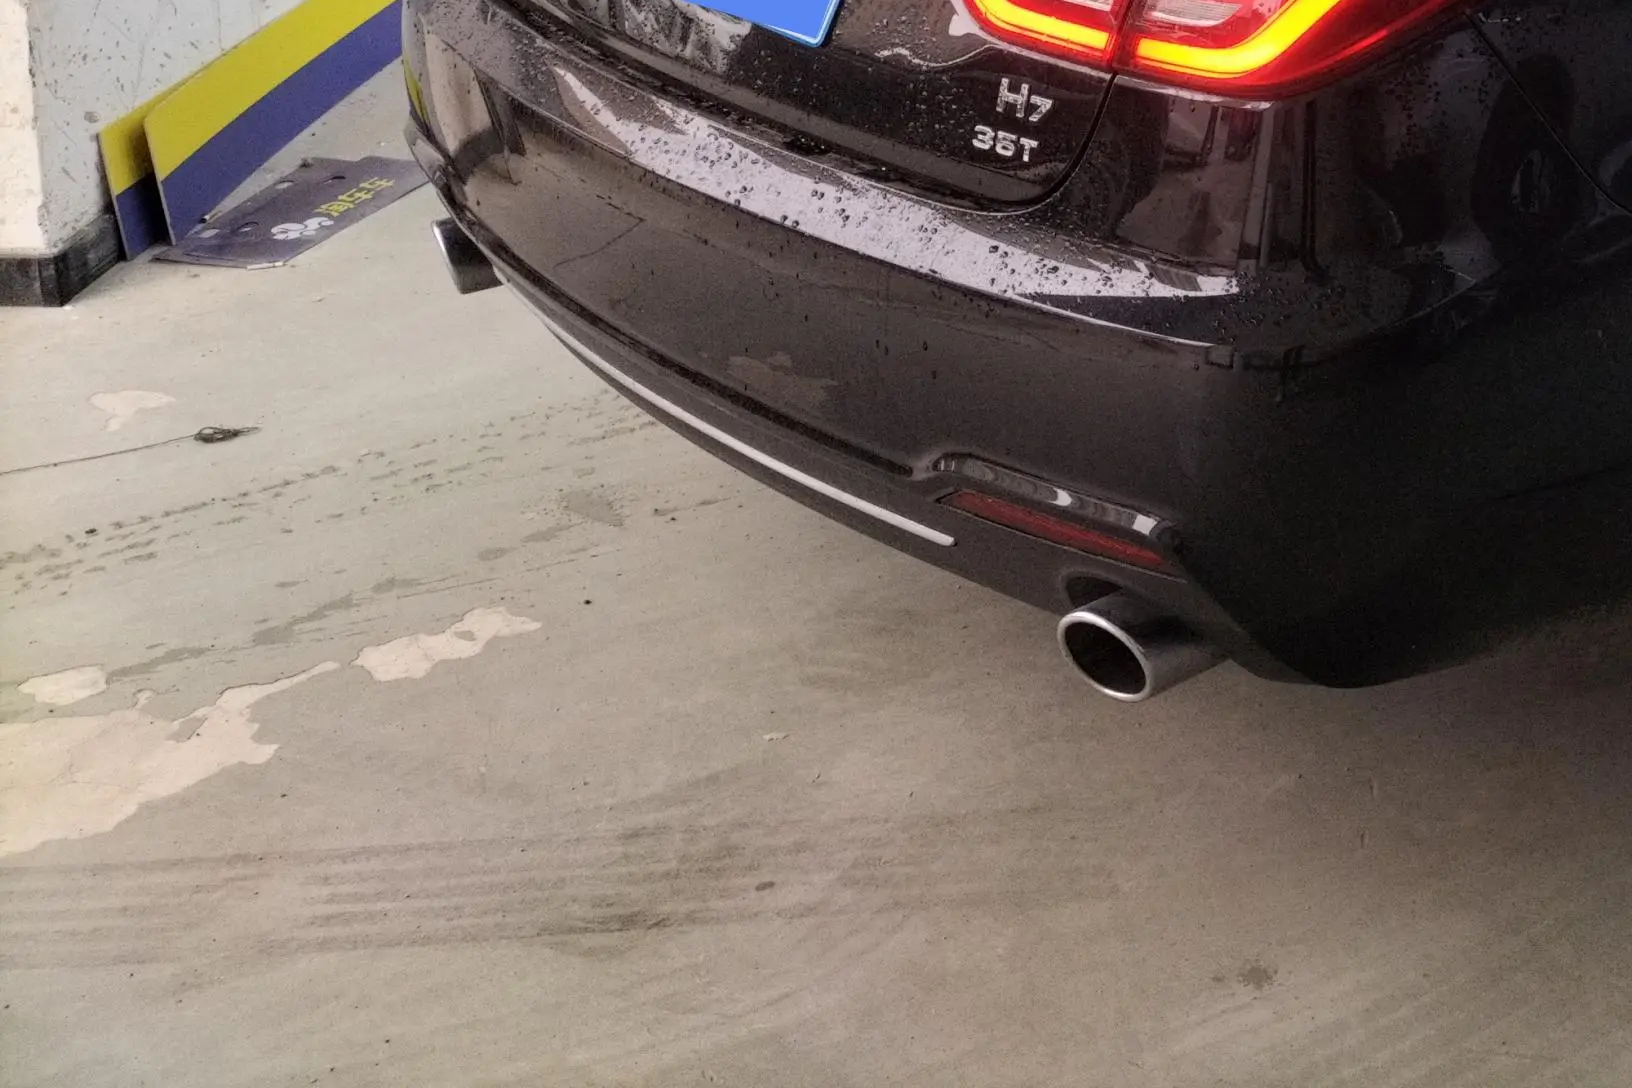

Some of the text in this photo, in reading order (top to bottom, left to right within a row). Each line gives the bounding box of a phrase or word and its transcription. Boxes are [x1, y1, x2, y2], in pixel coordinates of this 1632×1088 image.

[995, 76, 1054, 122] H7
[971, 124, 1040, 163] 35T
[312, 176, 396, 217] 淘车车
